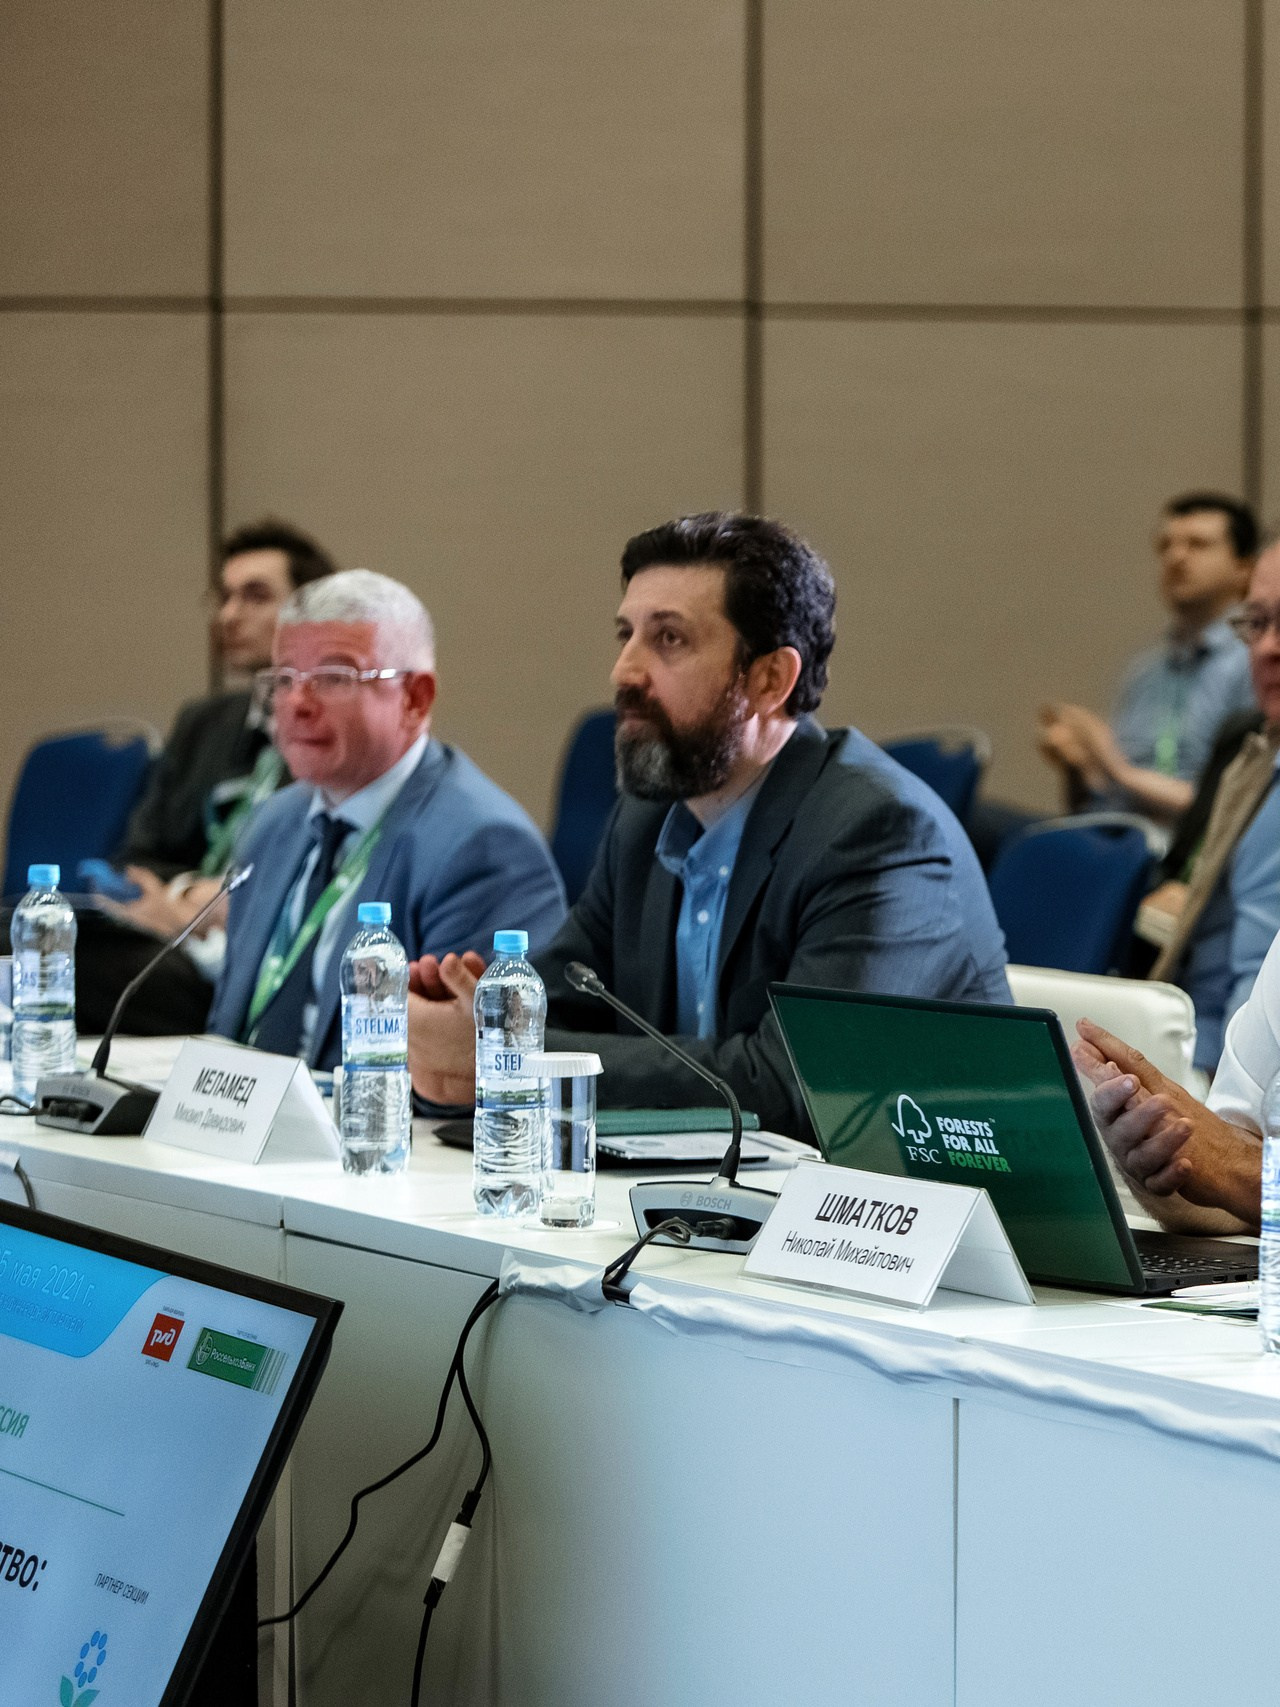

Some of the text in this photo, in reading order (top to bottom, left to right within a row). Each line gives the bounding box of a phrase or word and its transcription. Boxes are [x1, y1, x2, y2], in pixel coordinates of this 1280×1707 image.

[192, 1067, 258, 1110] МЕЛАМЕД
[935, 1116, 993, 1138] FORESTS
[906, 1145, 942, 1165] FSC
[941, 1133, 1000, 1155] FOR ALL
[947, 1151, 1012, 1173] FOREVER
[695, 1195, 732, 1211] BOSCH
[815, 1193, 919, 1236] ШМАТКОВ
[781, 1230, 915, 1274] Николай Михайлович
[0, 1249, 12, 1278] 5
[10, 1262, 42, 1288] мая
[41, 1264, 85, 1302] 2021
[0, 1541, 48, 1592] ТВО:
[94, 1572, 126, 1596] ПАРТНЕР
